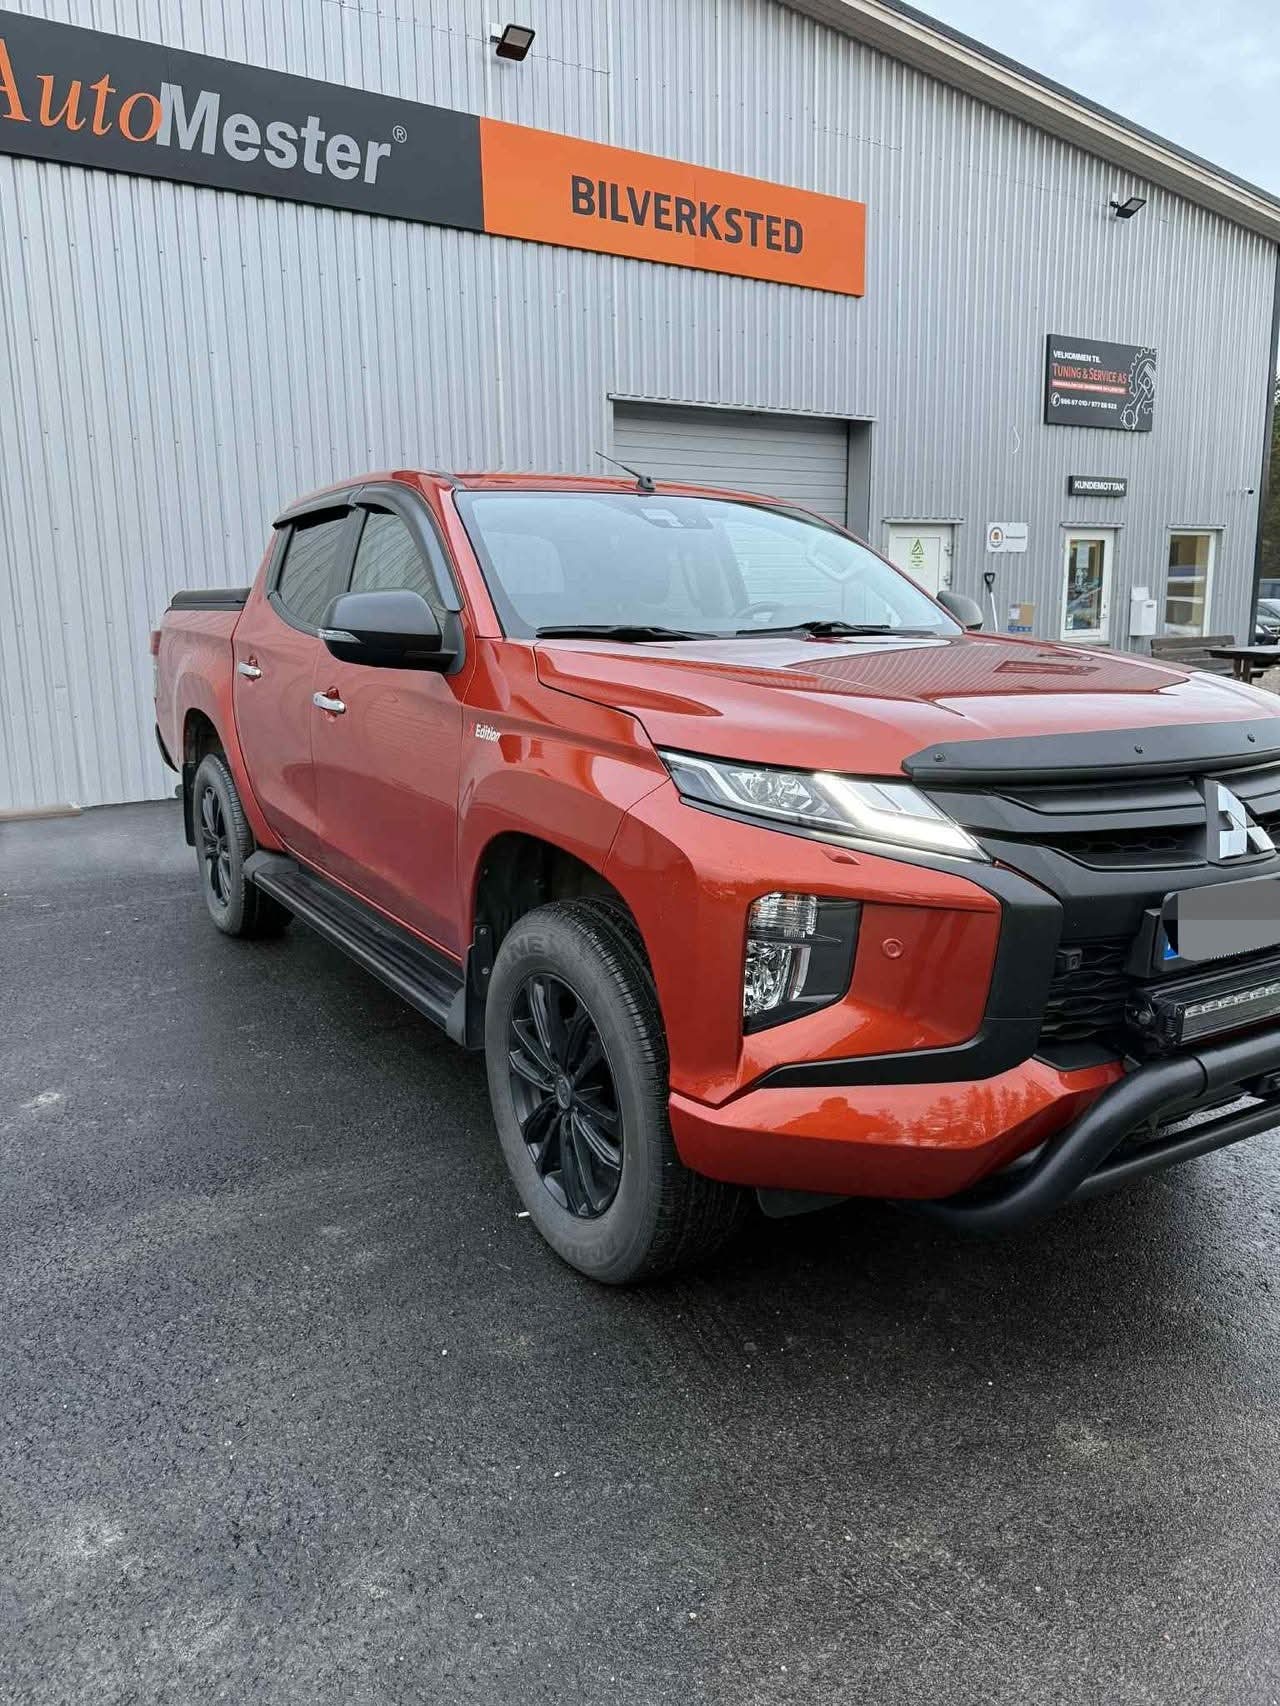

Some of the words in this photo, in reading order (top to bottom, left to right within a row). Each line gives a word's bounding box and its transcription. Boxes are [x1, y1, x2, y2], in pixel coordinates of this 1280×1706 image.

[571, 174, 803, 254] BILVERKSTED
[1082, 368, 1088, 379] &
[1117, 372, 1127, 384] AS
[1073, 480, 1125, 491] KUNDEMOTTAK
[475, 723, 501, 742] Edition
